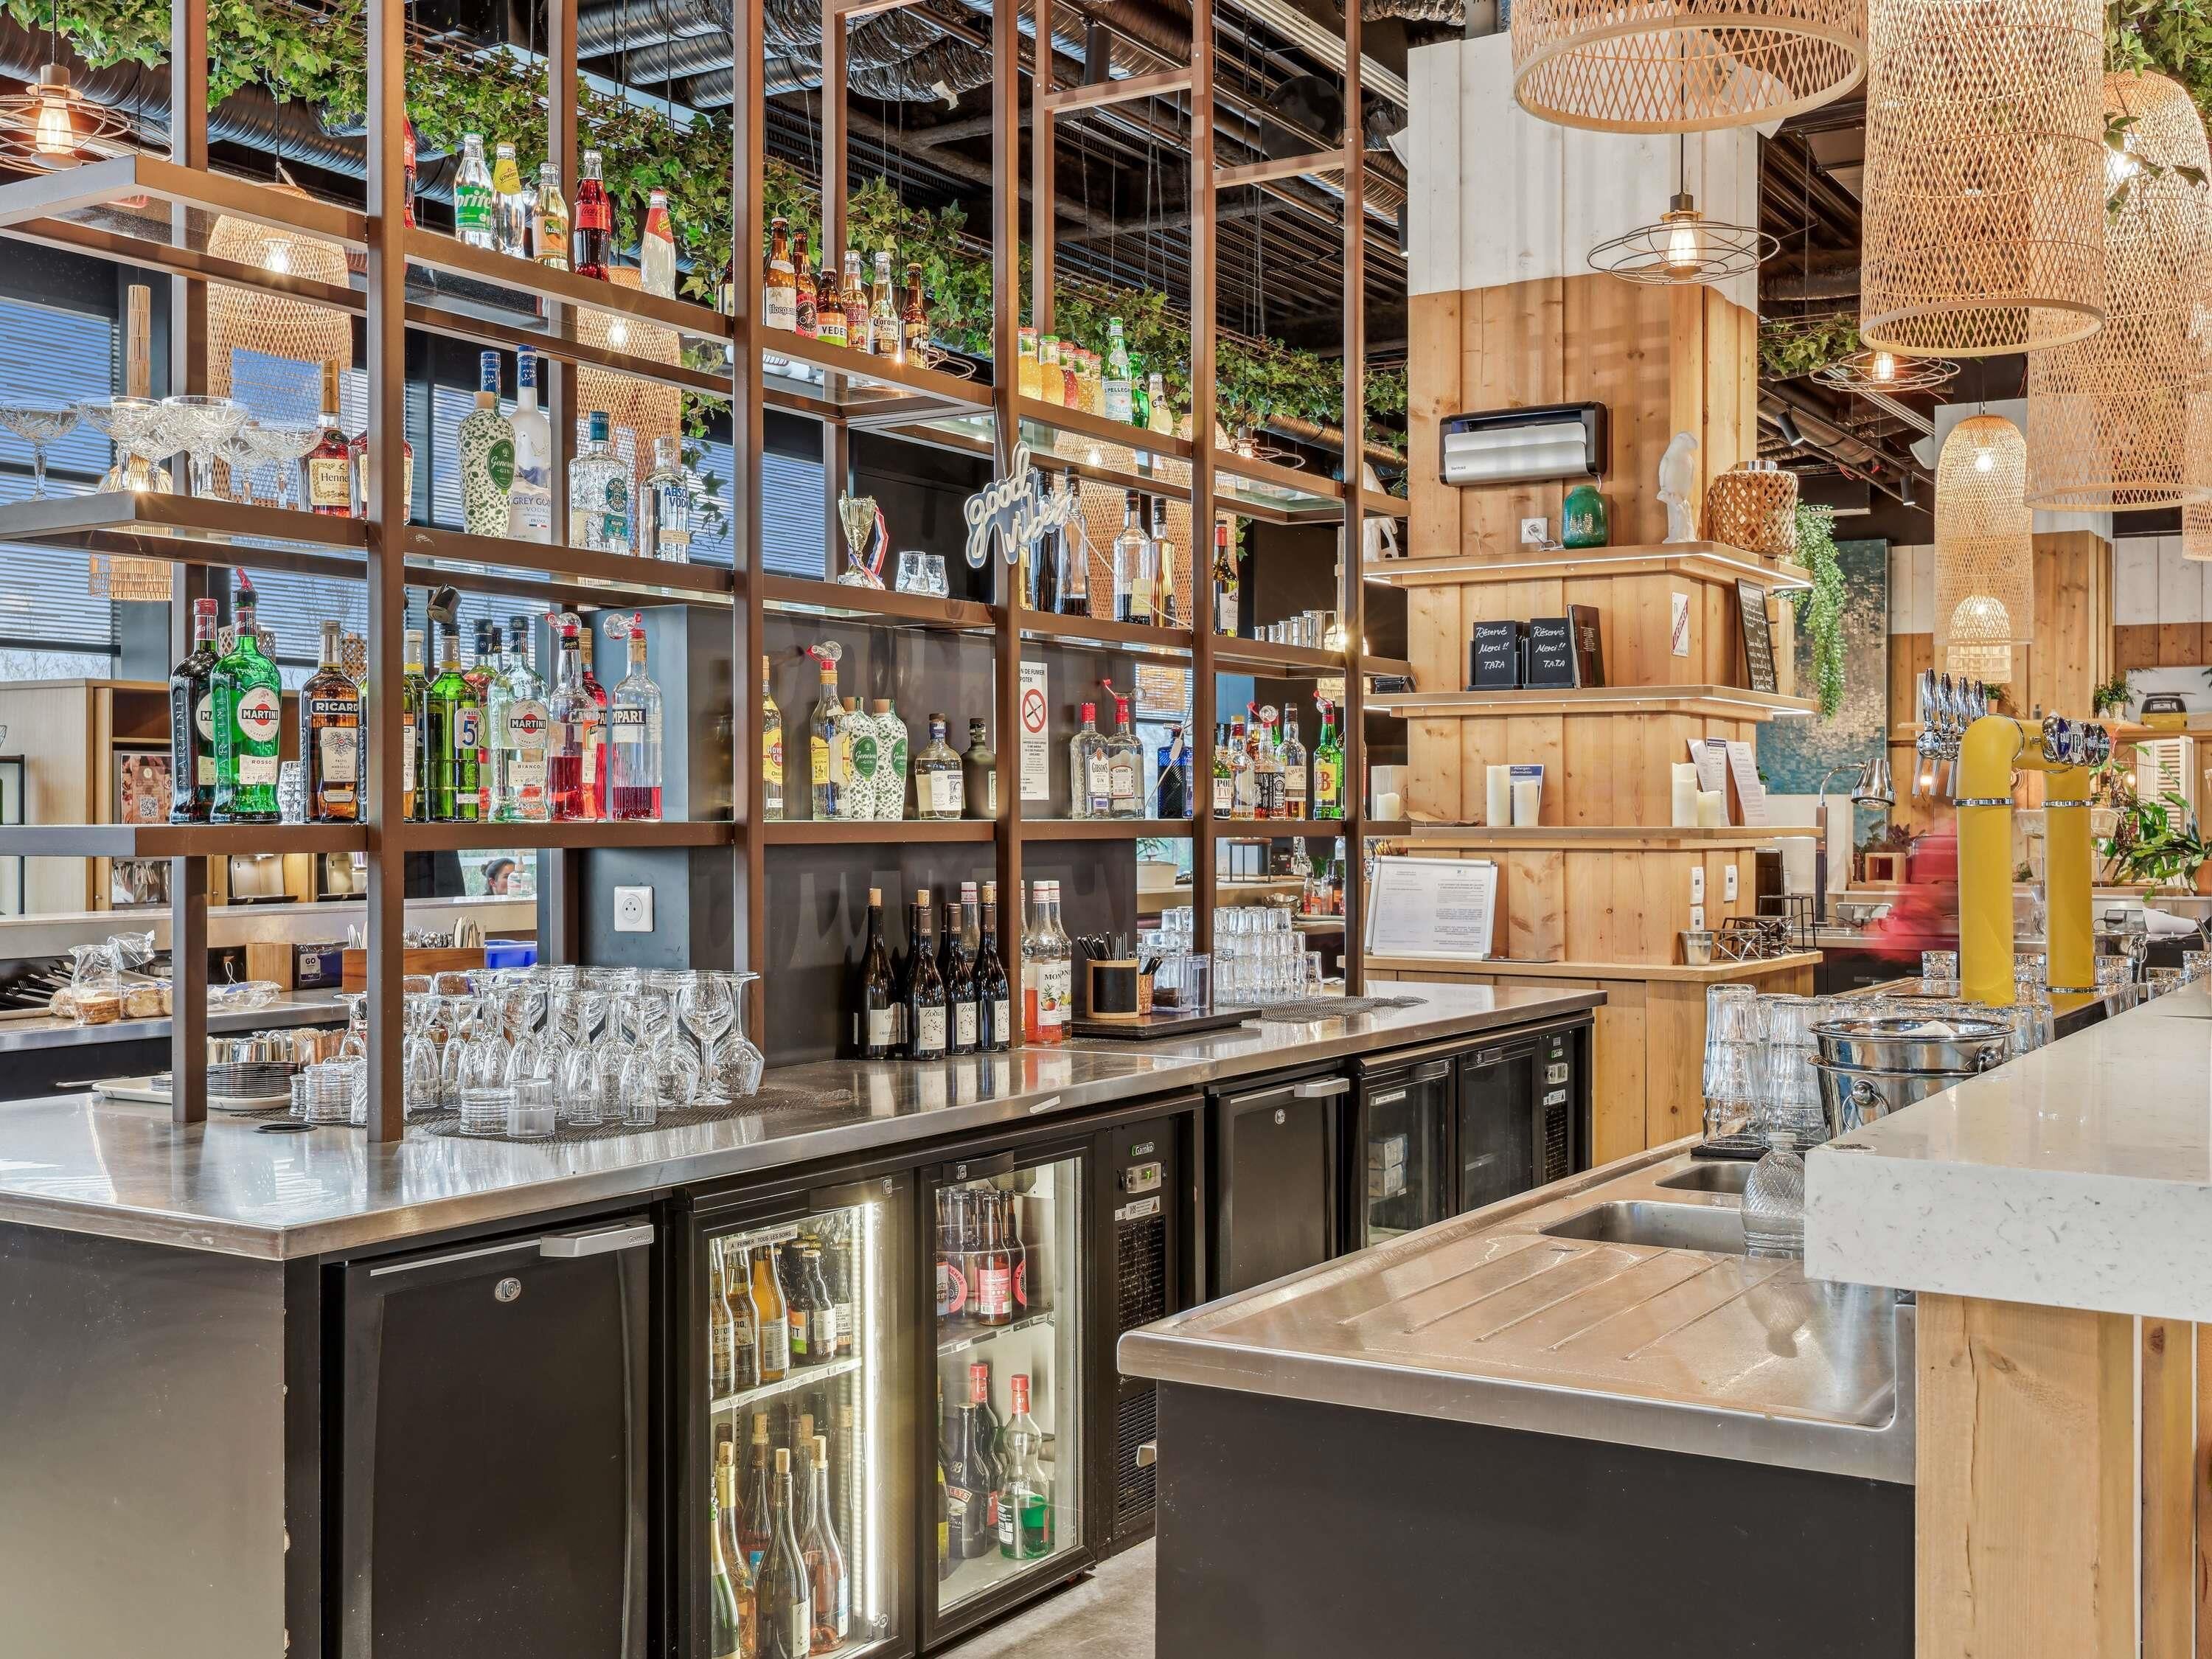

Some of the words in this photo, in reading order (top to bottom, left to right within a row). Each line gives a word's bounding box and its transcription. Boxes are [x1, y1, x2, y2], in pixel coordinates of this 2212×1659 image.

[456, 189, 492, 209] prite
[321, 472, 349, 481] Henne
[664, 487, 689, 498] ABSOL
[512, 497, 533, 505] GREY
[535, 497, 551, 507] GOO
[968, 447, 1032, 558] good
[1004, 490, 1074, 553] vibes
[1476, 627, 1508, 639] Réservé
[1534, 626, 1565, 638] Réservé
[316, 701, 358, 712] RICARD
[243, 709, 278, 720] MARTINI
[613, 710, 644, 723] MPARI.
[511, 718, 546, 728] MARTINI
[1044, 973, 1062, 981] MON
[737, 1239, 755, 1248] FERMER
[757, 1235, 769, 1243] TOUS
[779, 1231, 792, 1239] SOIRS
[949, 1488, 969, 1500] LEYS
